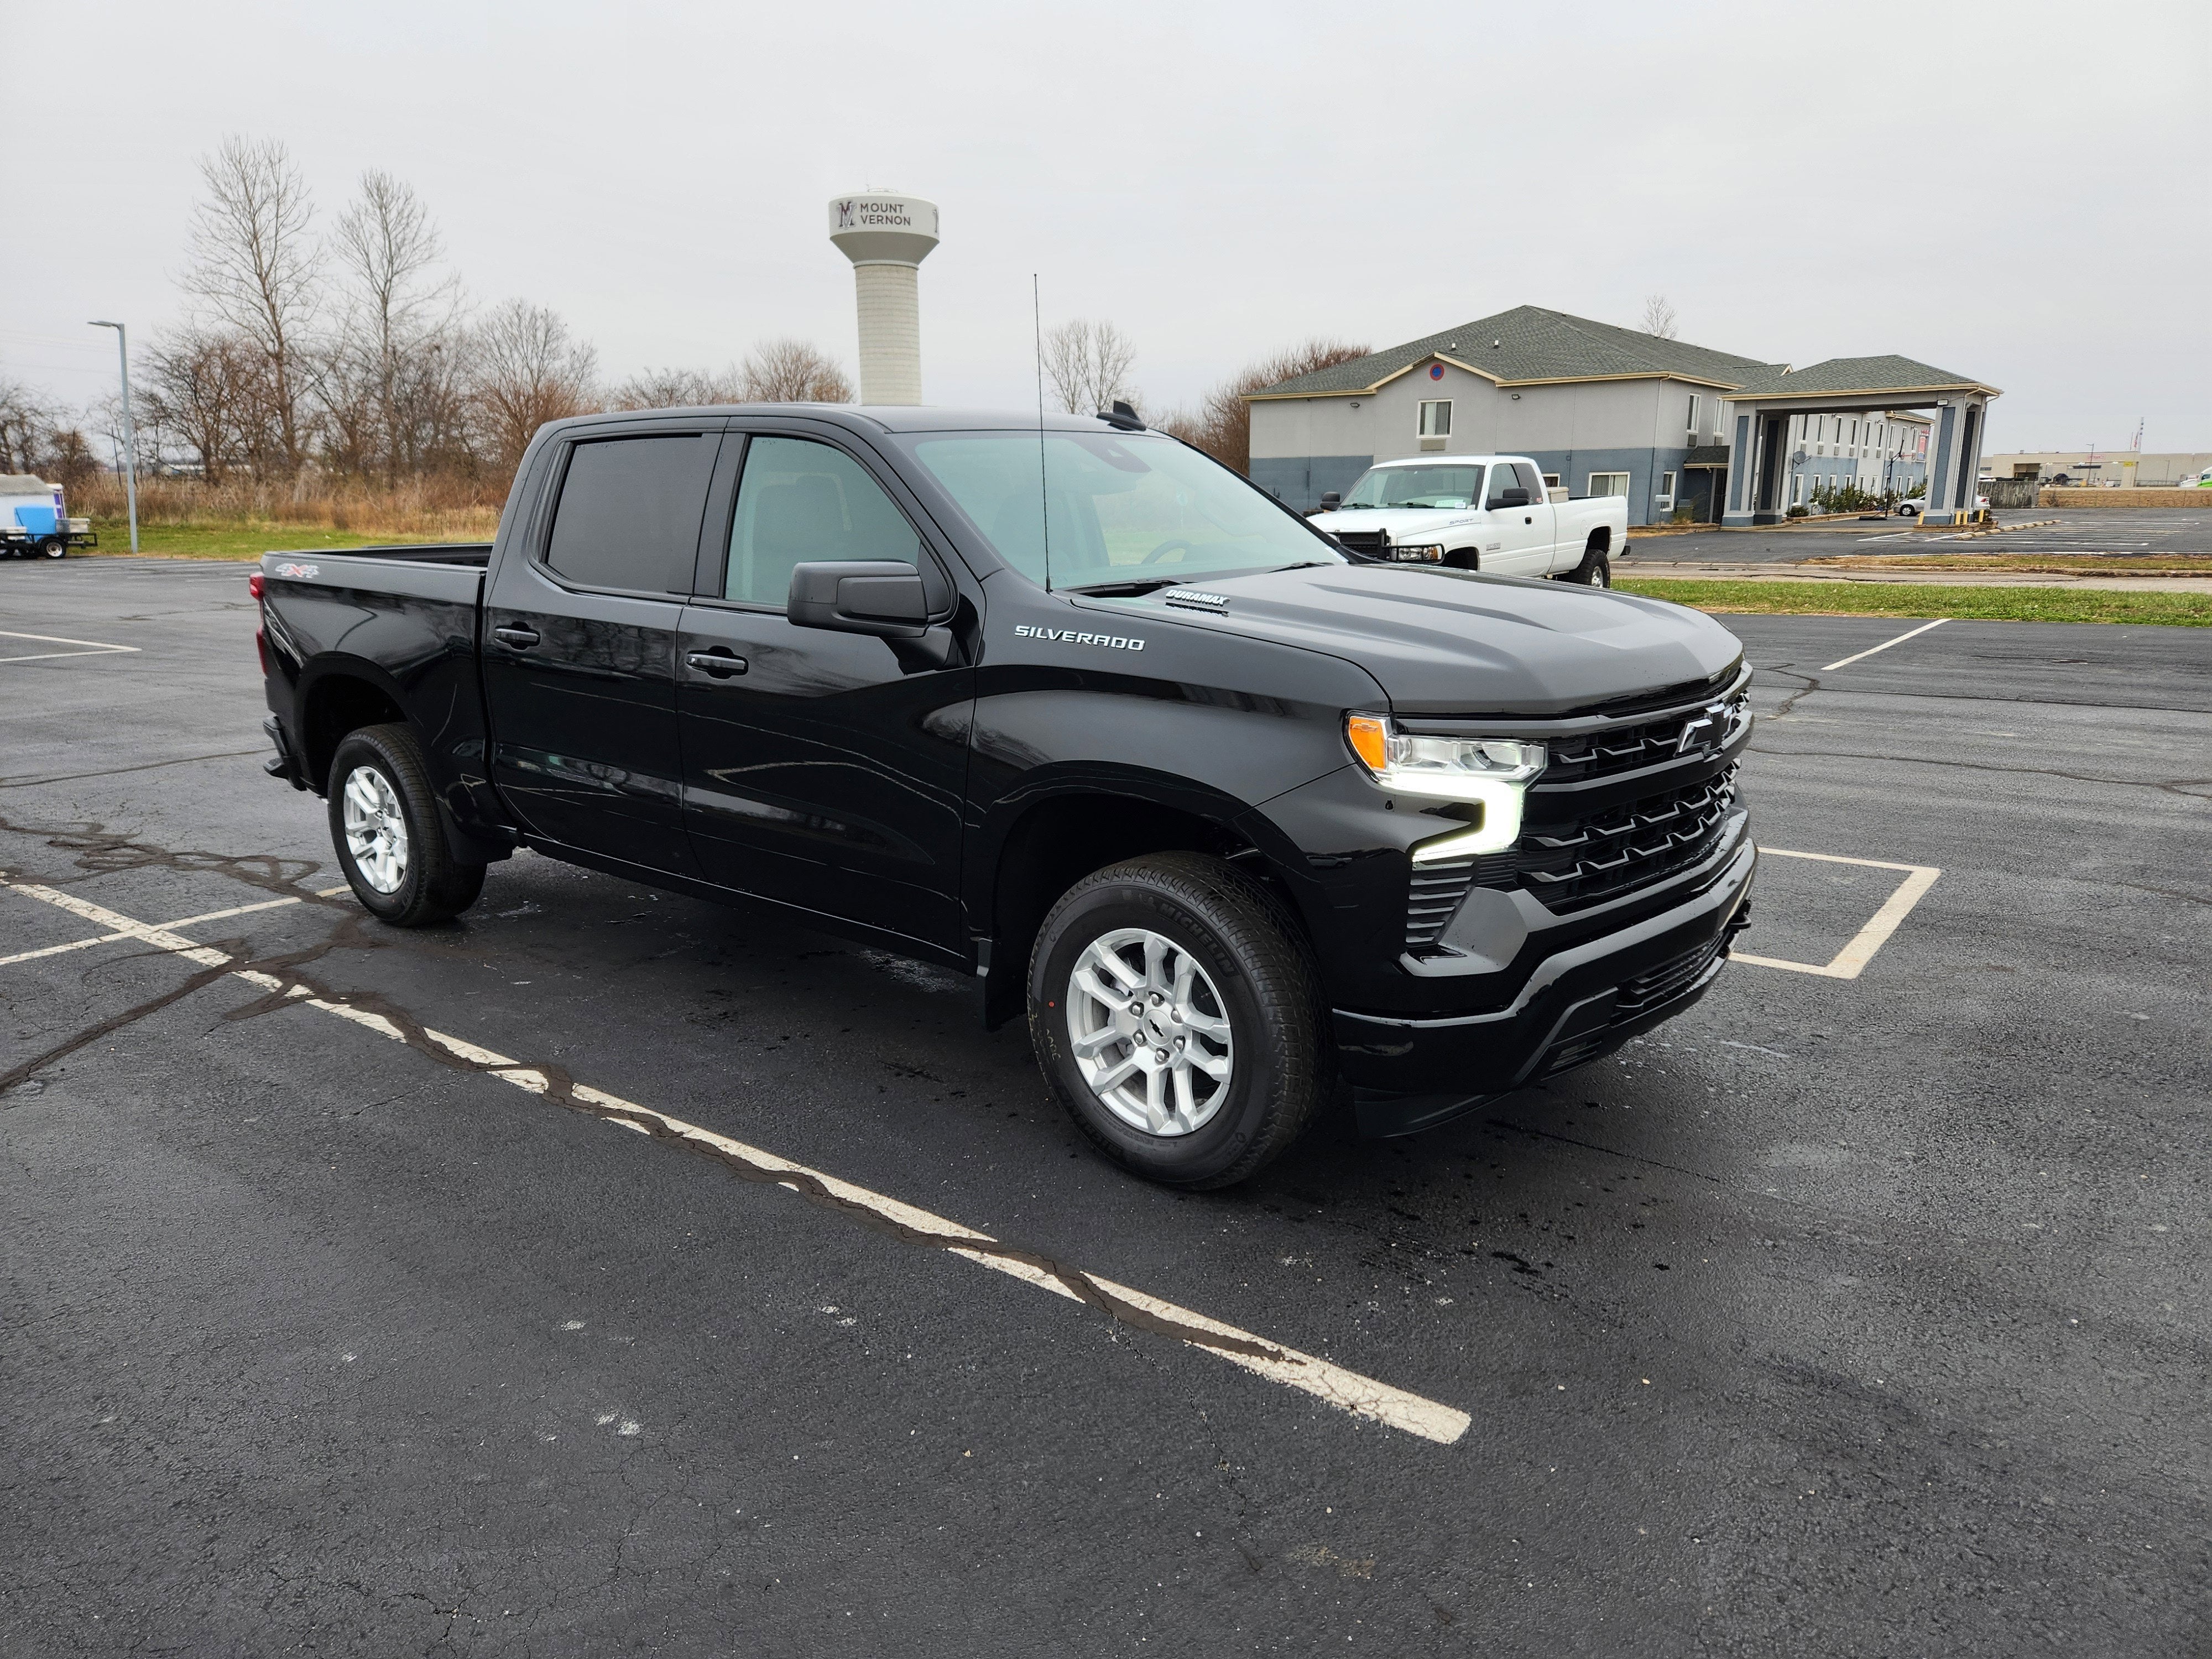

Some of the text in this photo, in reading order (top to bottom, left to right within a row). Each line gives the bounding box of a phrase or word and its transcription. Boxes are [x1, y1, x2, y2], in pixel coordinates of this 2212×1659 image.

[860, 203, 904, 213] MOUNT
[860, 215, 911, 226] VERNON
[1165, 589, 1231, 607] DURAMAX
[1014, 625, 1145, 651] SILVERADO
[1159, 902, 1235, 972] MICHELIN
